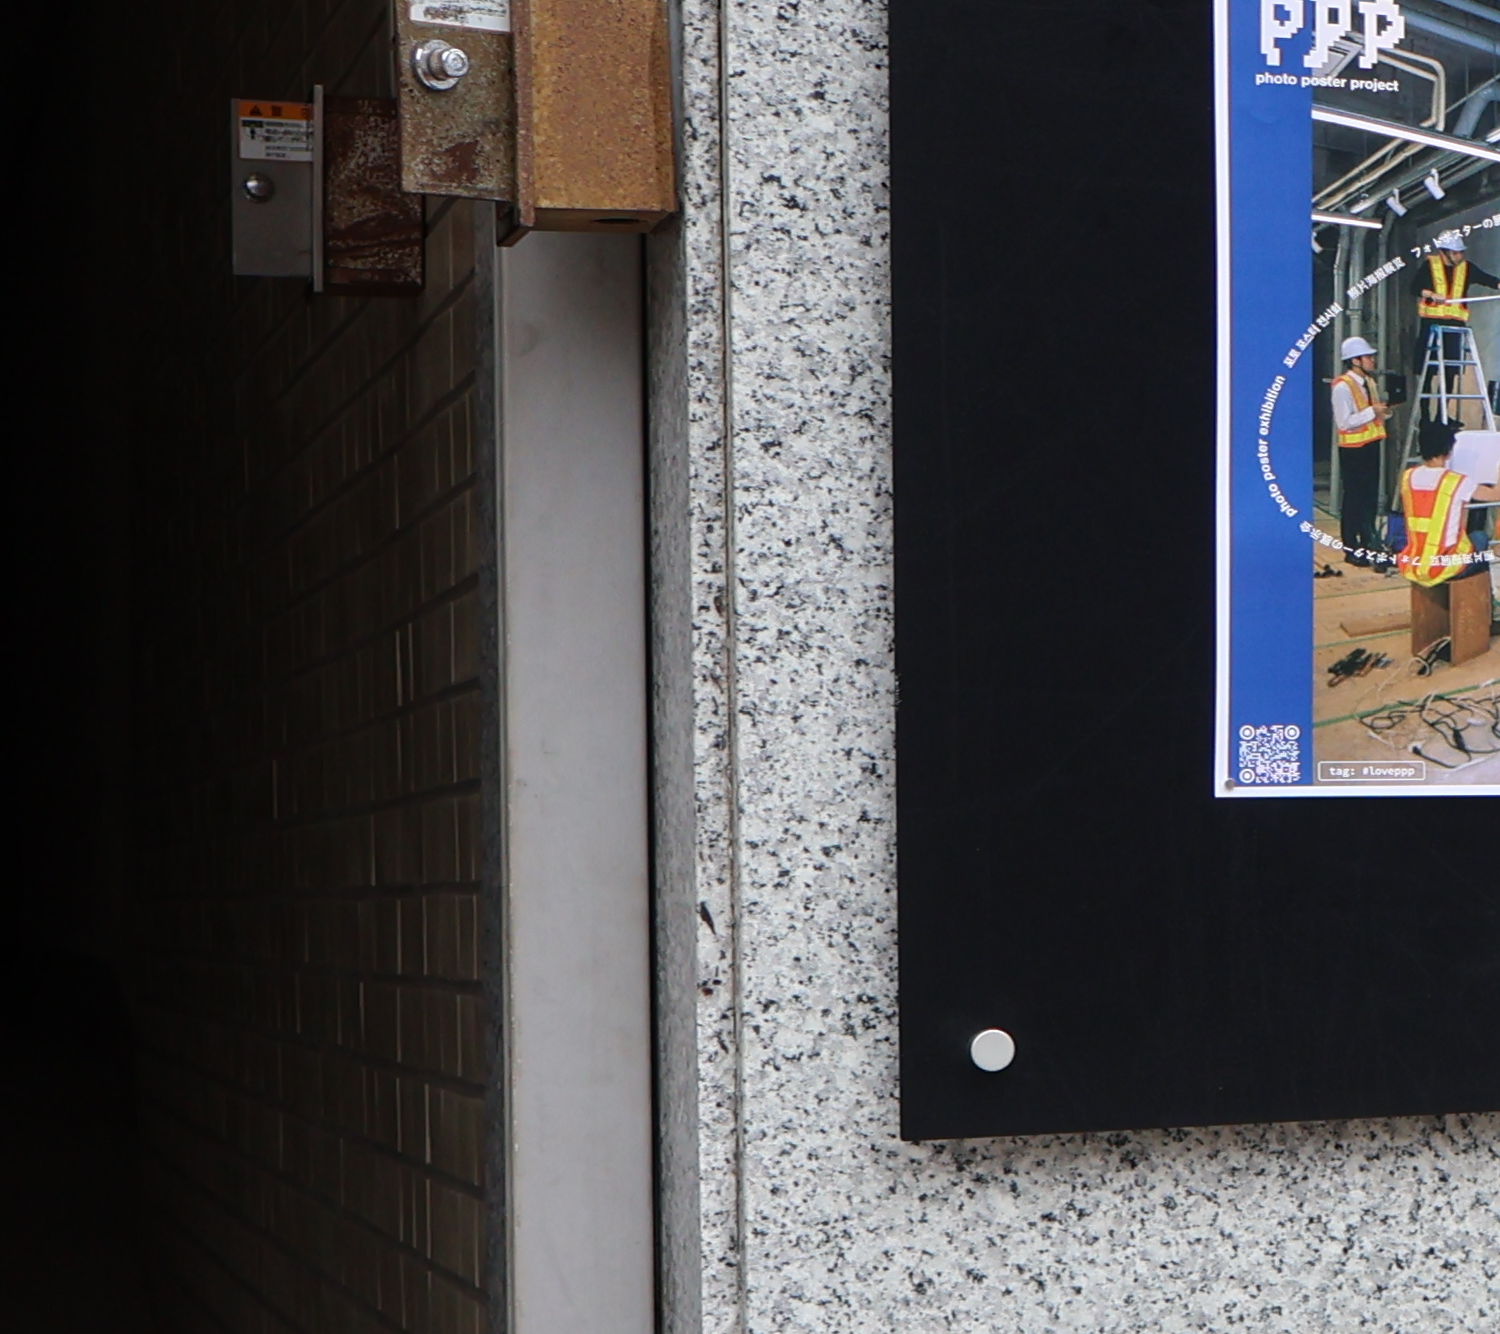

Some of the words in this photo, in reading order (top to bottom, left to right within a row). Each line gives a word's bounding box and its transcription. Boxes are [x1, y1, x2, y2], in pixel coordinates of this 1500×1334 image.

[1255, 71, 1298, 86] photo
[1301, 75, 1346, 88] poster
[1349, 78, 1399, 92] project
[1258, 375, 1286, 436] exhibition
[1257, 439, 1276, 481] poster
[1268, 483, 1298, 518] photo
[1329, 767, 1355, 778] tag:
[1362, 766, 1415, 777] #loveppp
